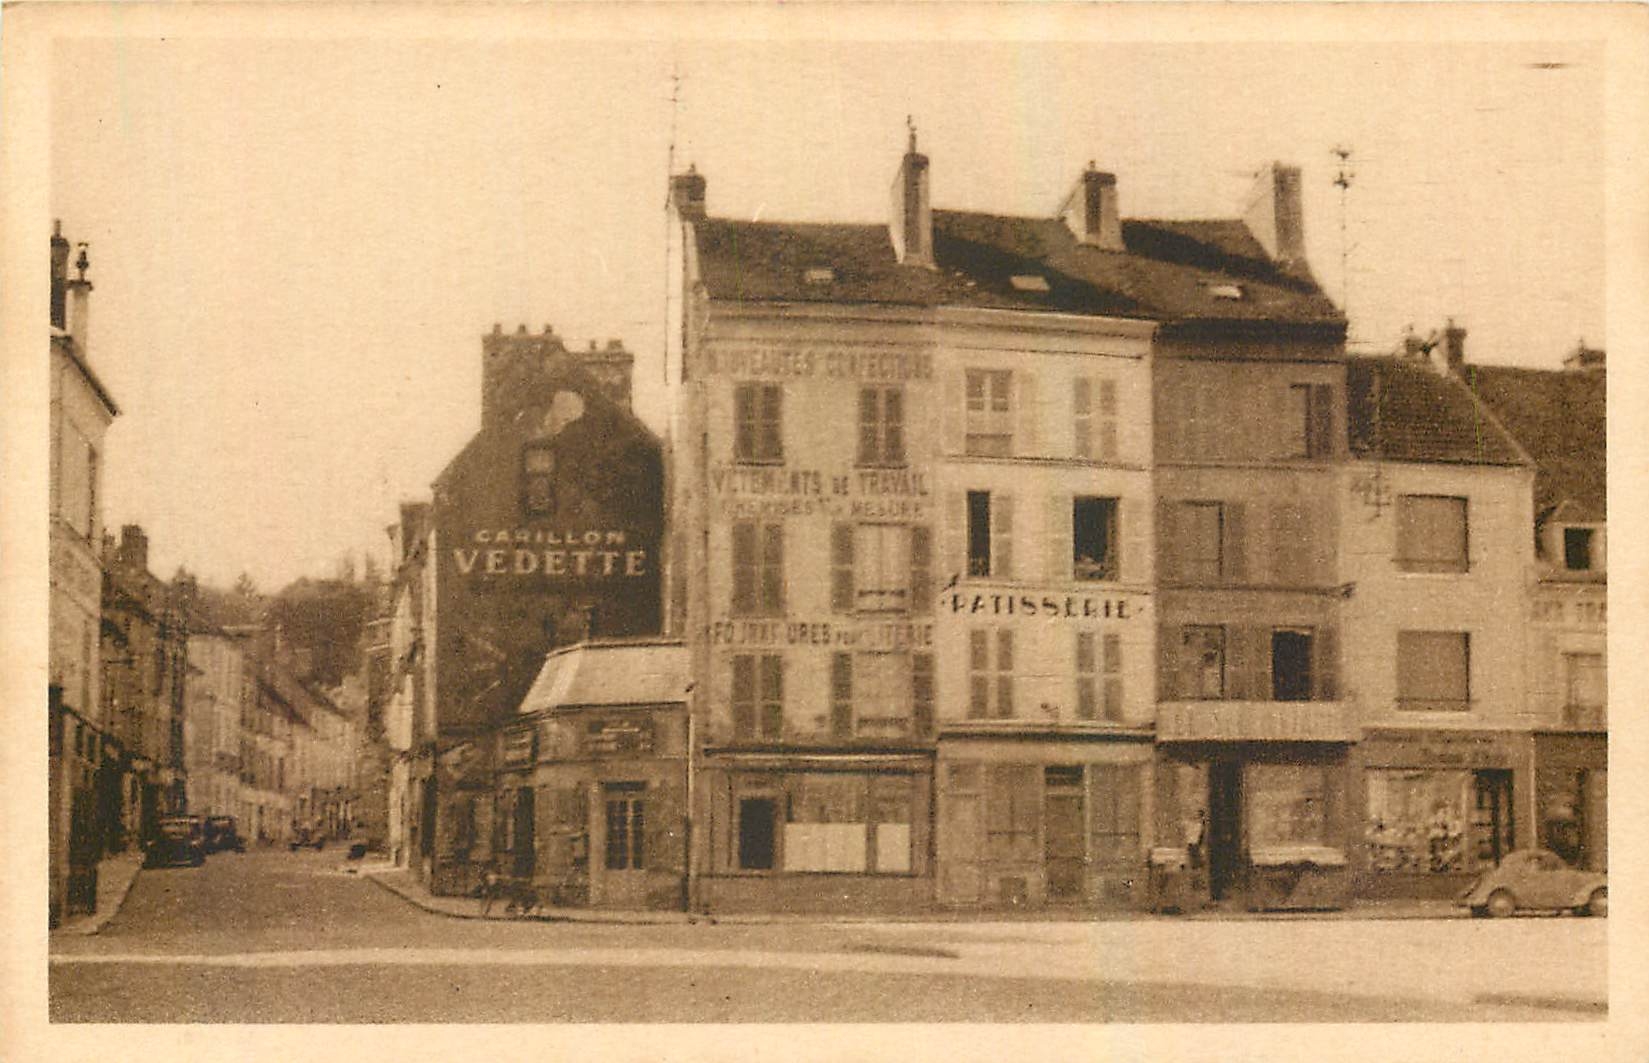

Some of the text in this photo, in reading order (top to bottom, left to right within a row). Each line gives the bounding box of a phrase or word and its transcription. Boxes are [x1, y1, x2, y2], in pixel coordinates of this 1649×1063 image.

[475, 529, 626, 545] CARILLON
[453, 548, 647, 577] VEDETTE
[951, 594, 1131, 619] PATISSERIE
